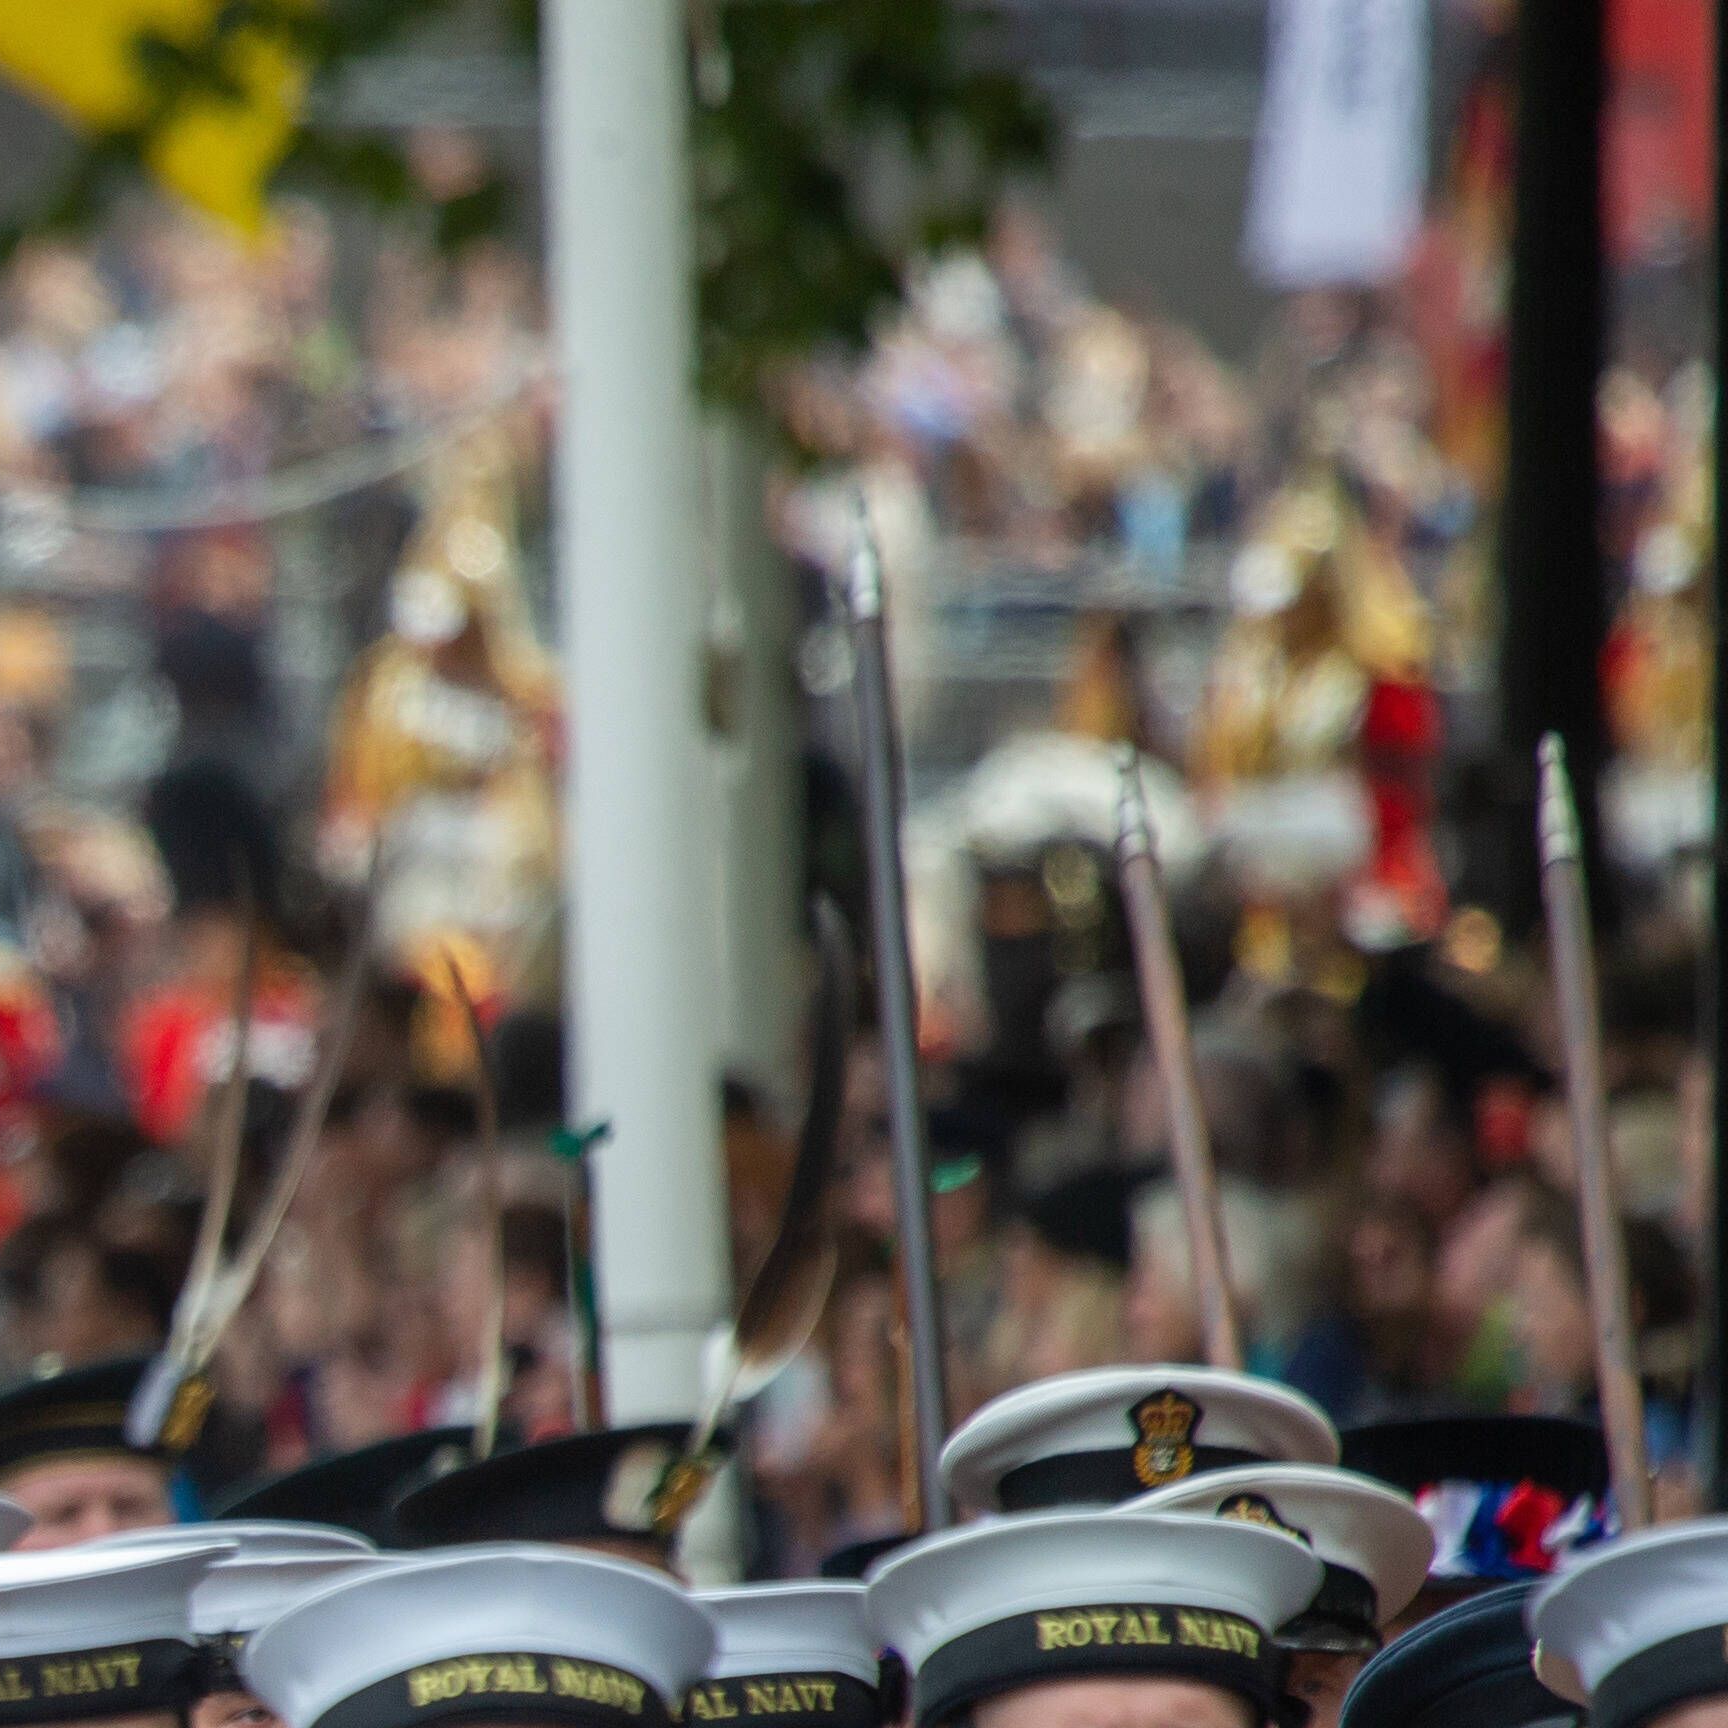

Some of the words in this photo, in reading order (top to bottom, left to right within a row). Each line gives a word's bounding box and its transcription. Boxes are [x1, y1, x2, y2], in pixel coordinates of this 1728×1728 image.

[1036, 1611, 1172, 1650] ROYAL
[1175, 1609, 1260, 1659] NAVY
[39, 1653, 142, 1698] NAVY
[407, 1655, 548, 1708] ROYAL
[744, 1679, 837, 1715] NAVY
